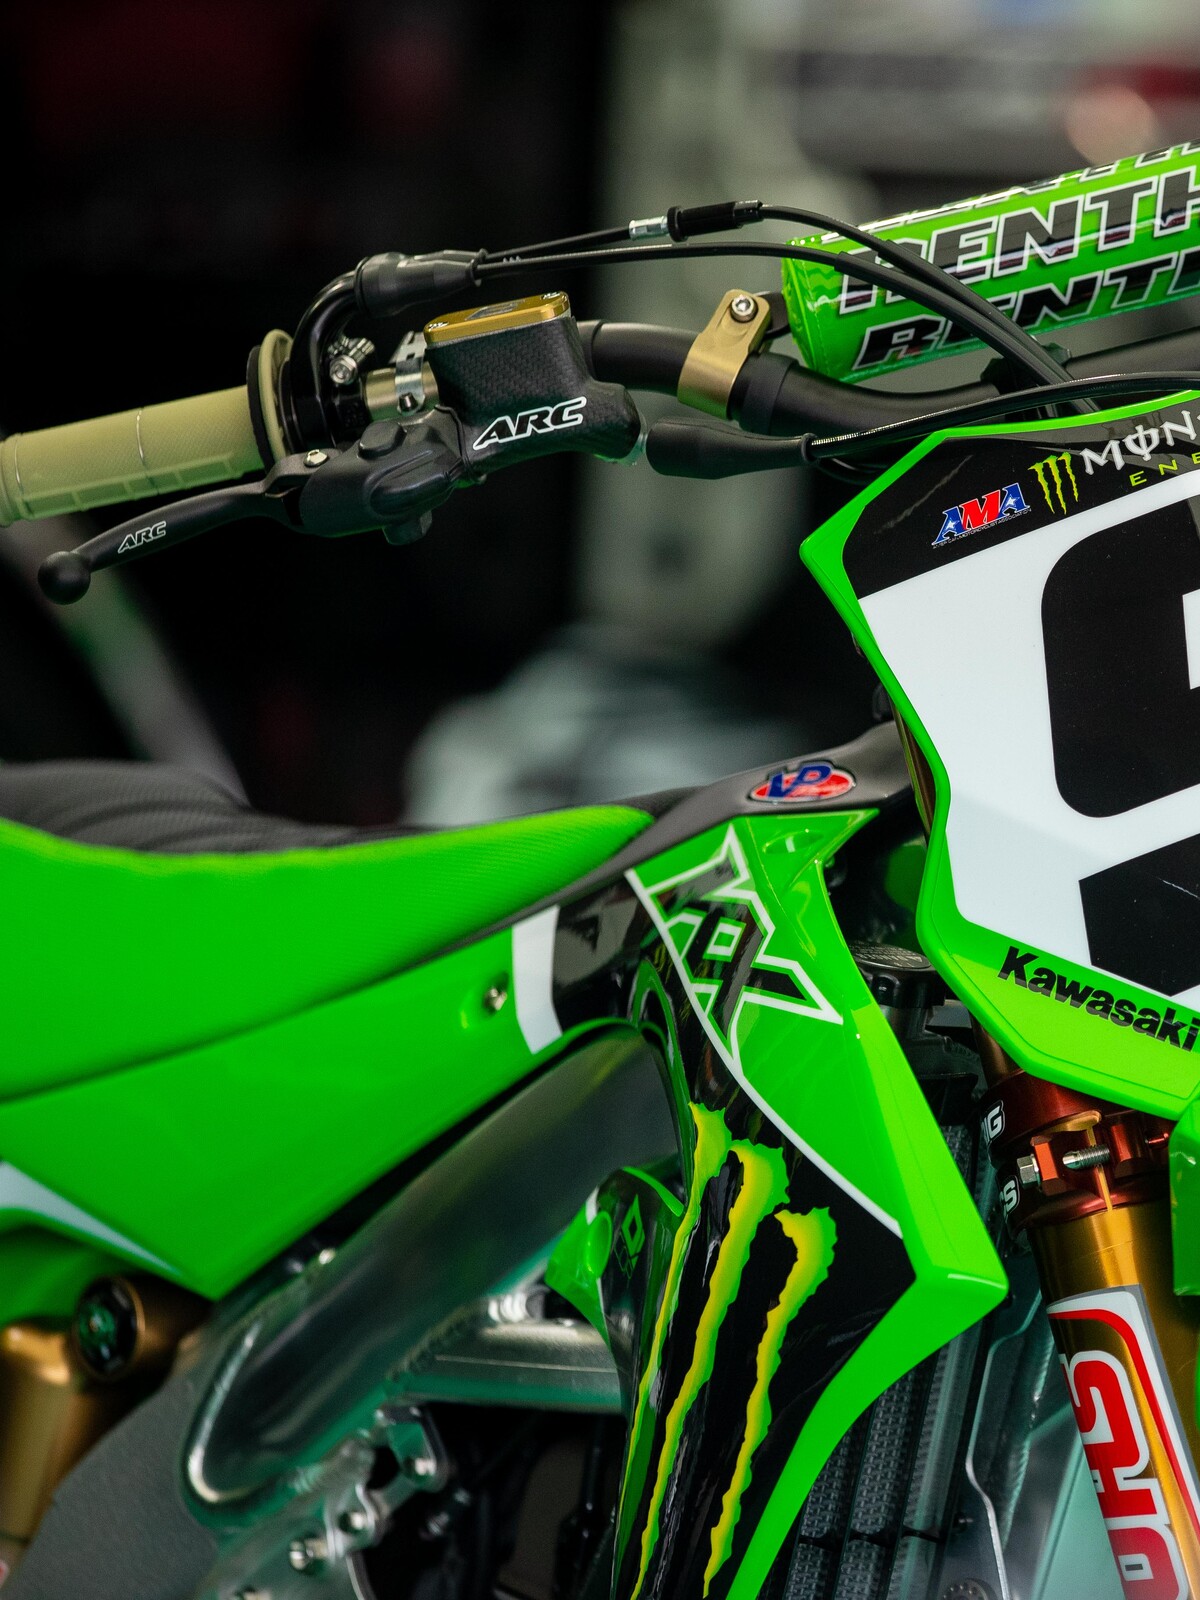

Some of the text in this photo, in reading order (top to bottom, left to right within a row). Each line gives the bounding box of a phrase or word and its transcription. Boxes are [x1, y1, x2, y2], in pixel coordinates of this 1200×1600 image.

[473, 396, 587, 450] ARC
[931, 482, 1031, 546] AMA
[117, 520, 167, 554] ARC
[766, 764, 833, 798] VP
